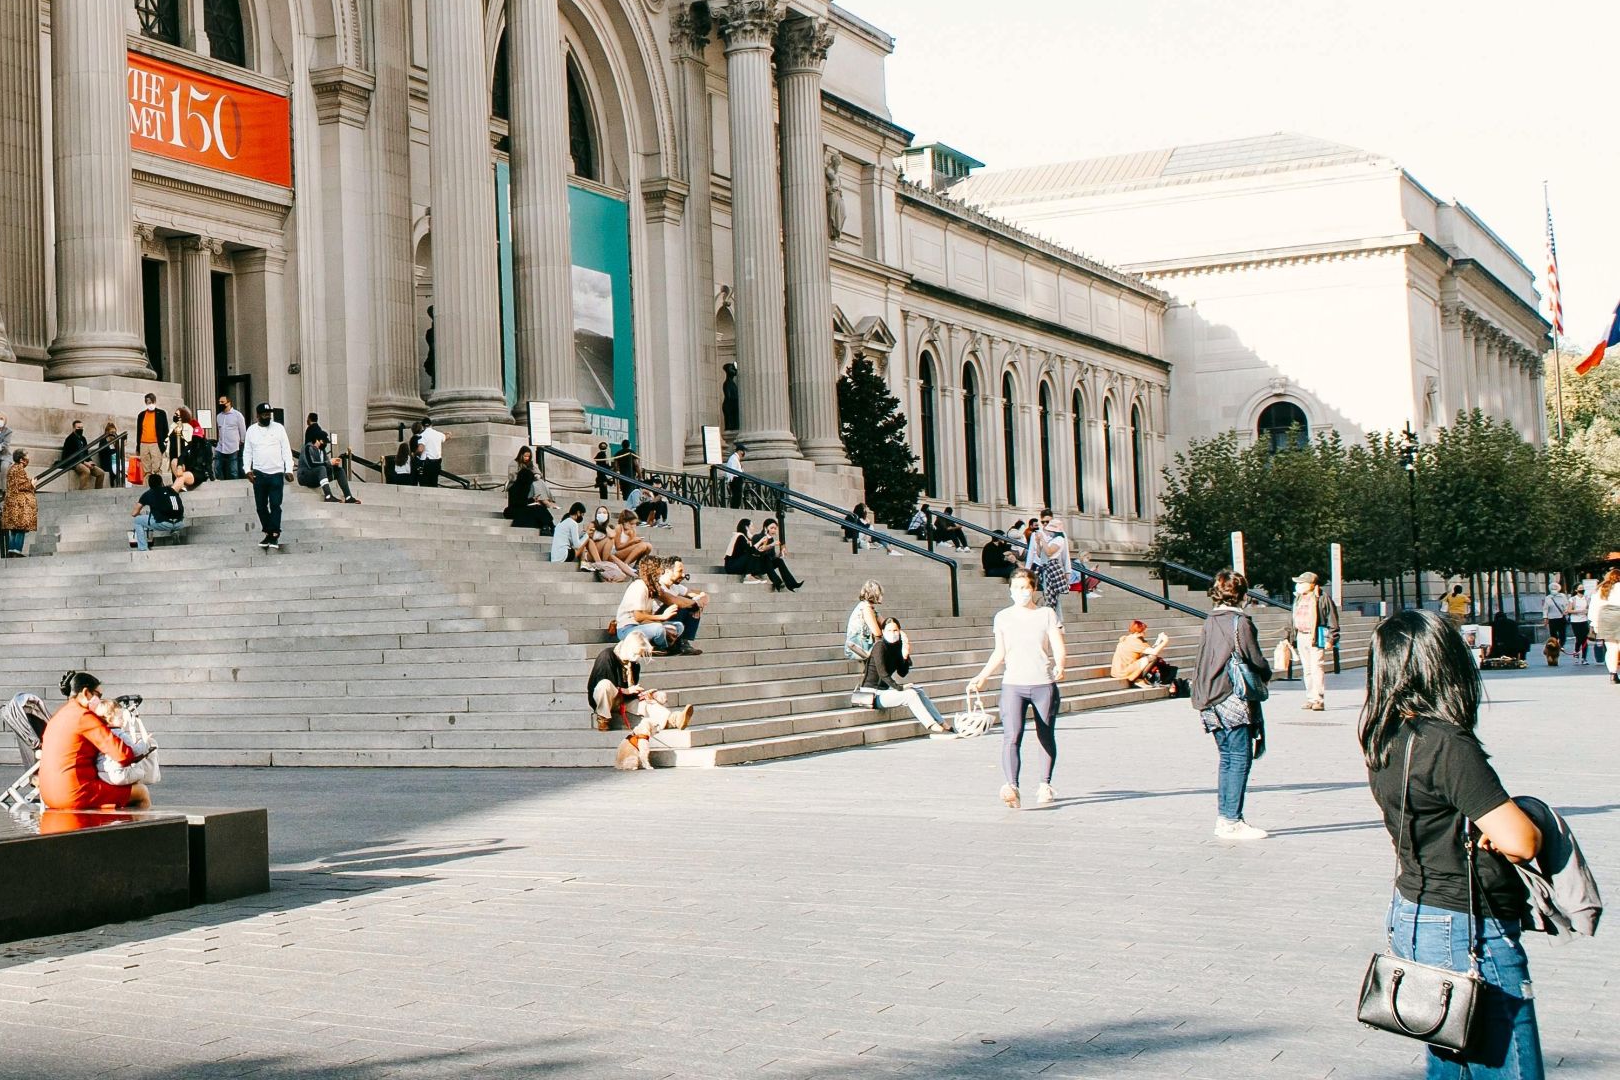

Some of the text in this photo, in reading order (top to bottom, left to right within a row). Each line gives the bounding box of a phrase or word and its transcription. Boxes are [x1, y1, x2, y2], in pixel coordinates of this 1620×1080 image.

[128, 67, 165, 108] THE
[128, 102, 166, 142] MET
[168, 80, 242, 160] 150
